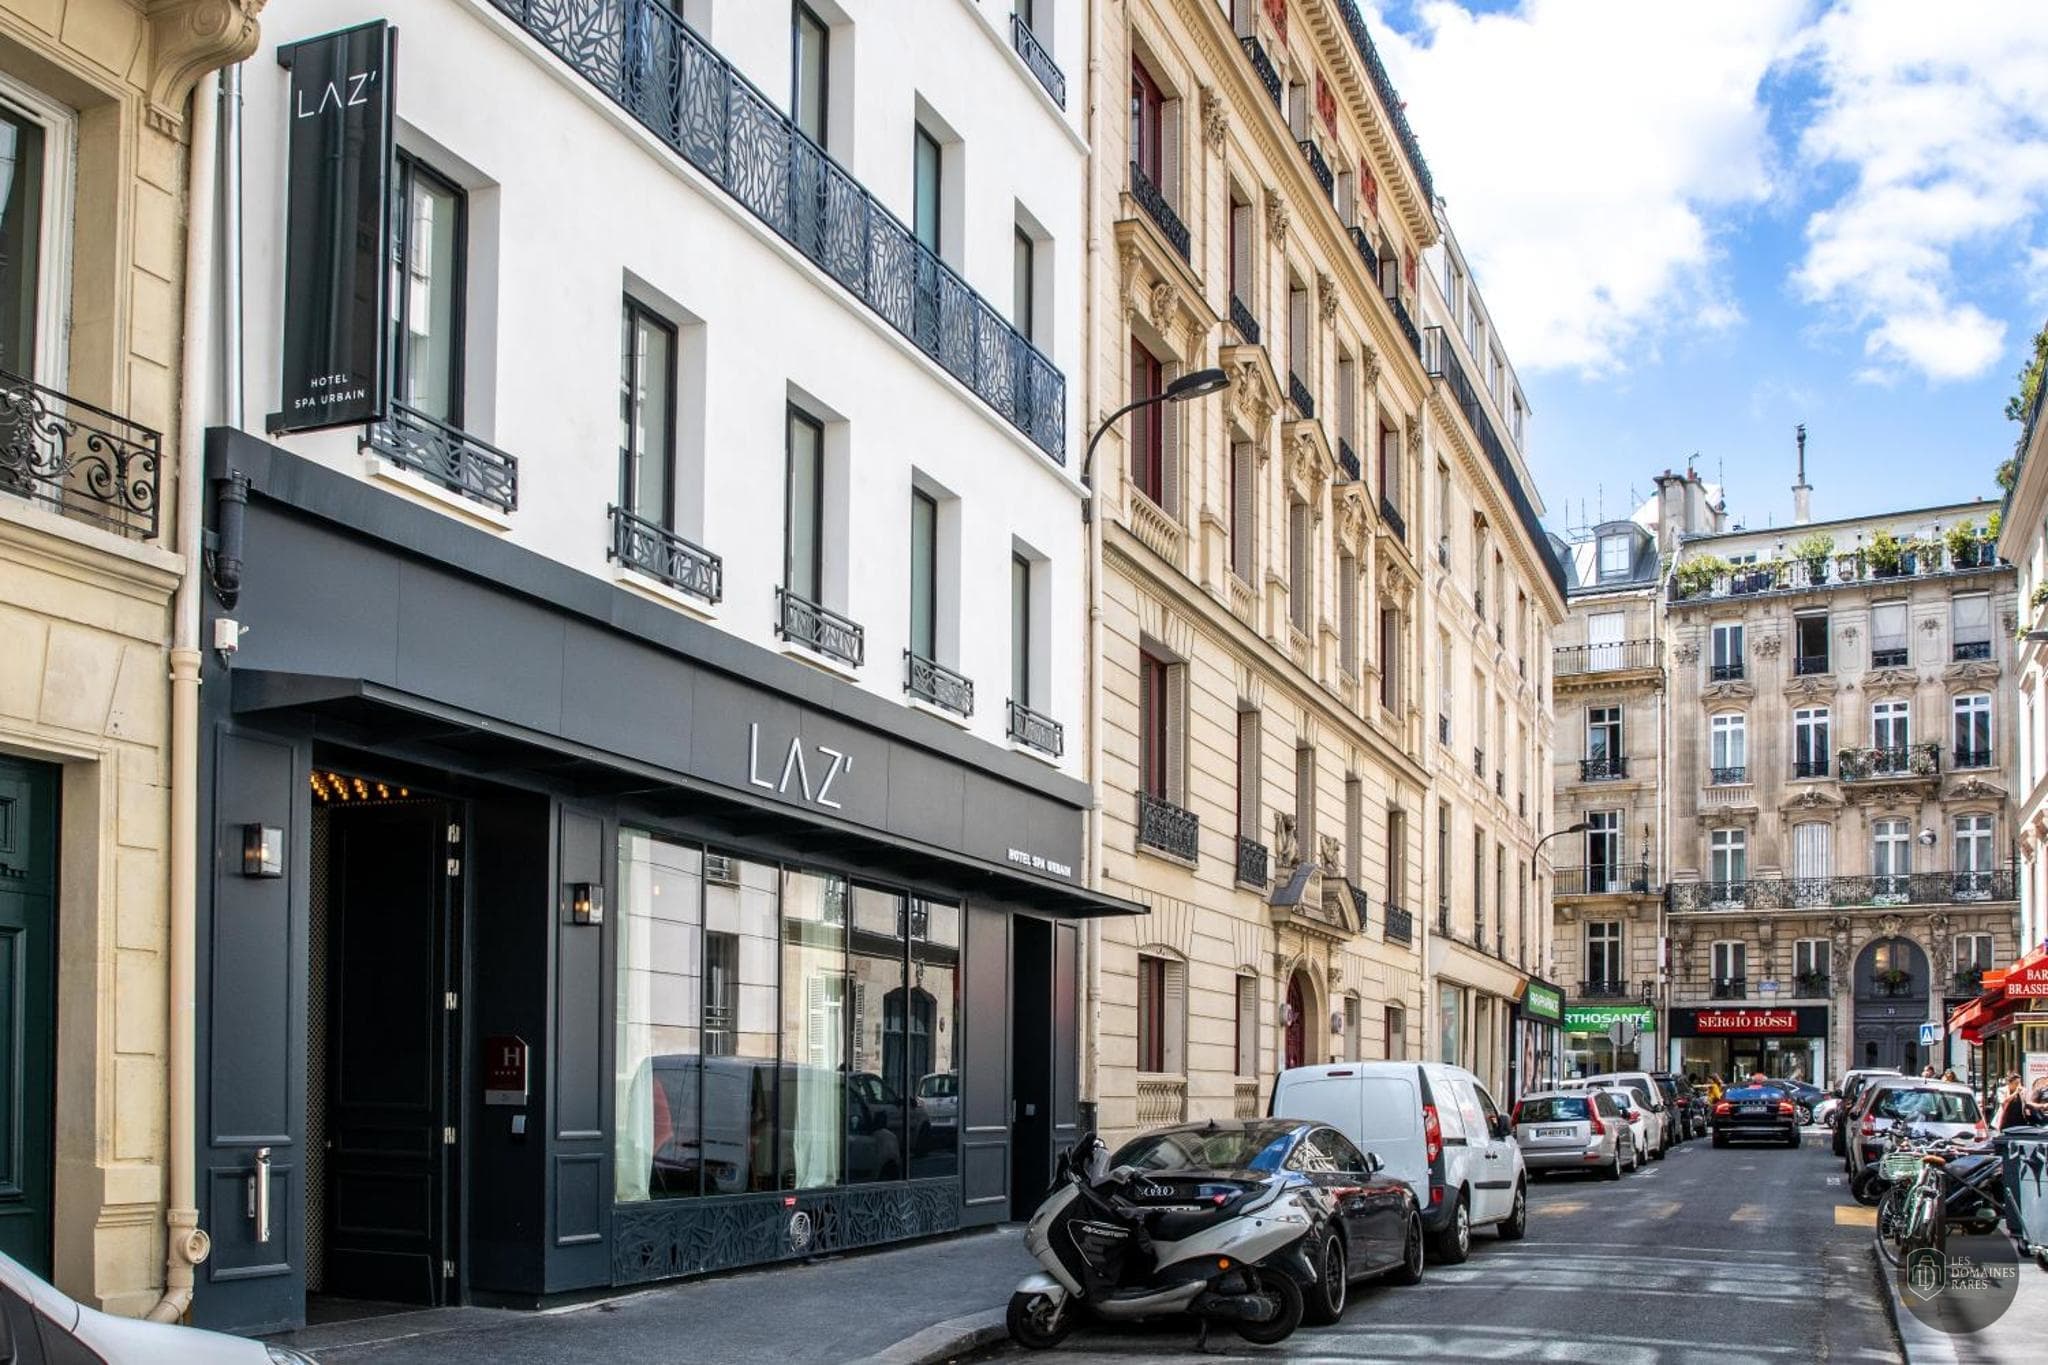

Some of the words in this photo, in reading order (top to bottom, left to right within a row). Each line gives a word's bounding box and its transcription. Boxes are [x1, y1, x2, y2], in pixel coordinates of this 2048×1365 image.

[311, 373, 348, 388] HOTEL
[294, 395, 316, 409] SPA
[320, 388, 365, 405] URBAIN
[1008, 848, 1032, 866] HOTEL
[1032, 856, 1045, 870] SPA
[1698, 1016, 1750, 1028] SERGIO
[1753, 1016, 1793, 1028] BOSSI
[503, 1046, 520, 1066] H
